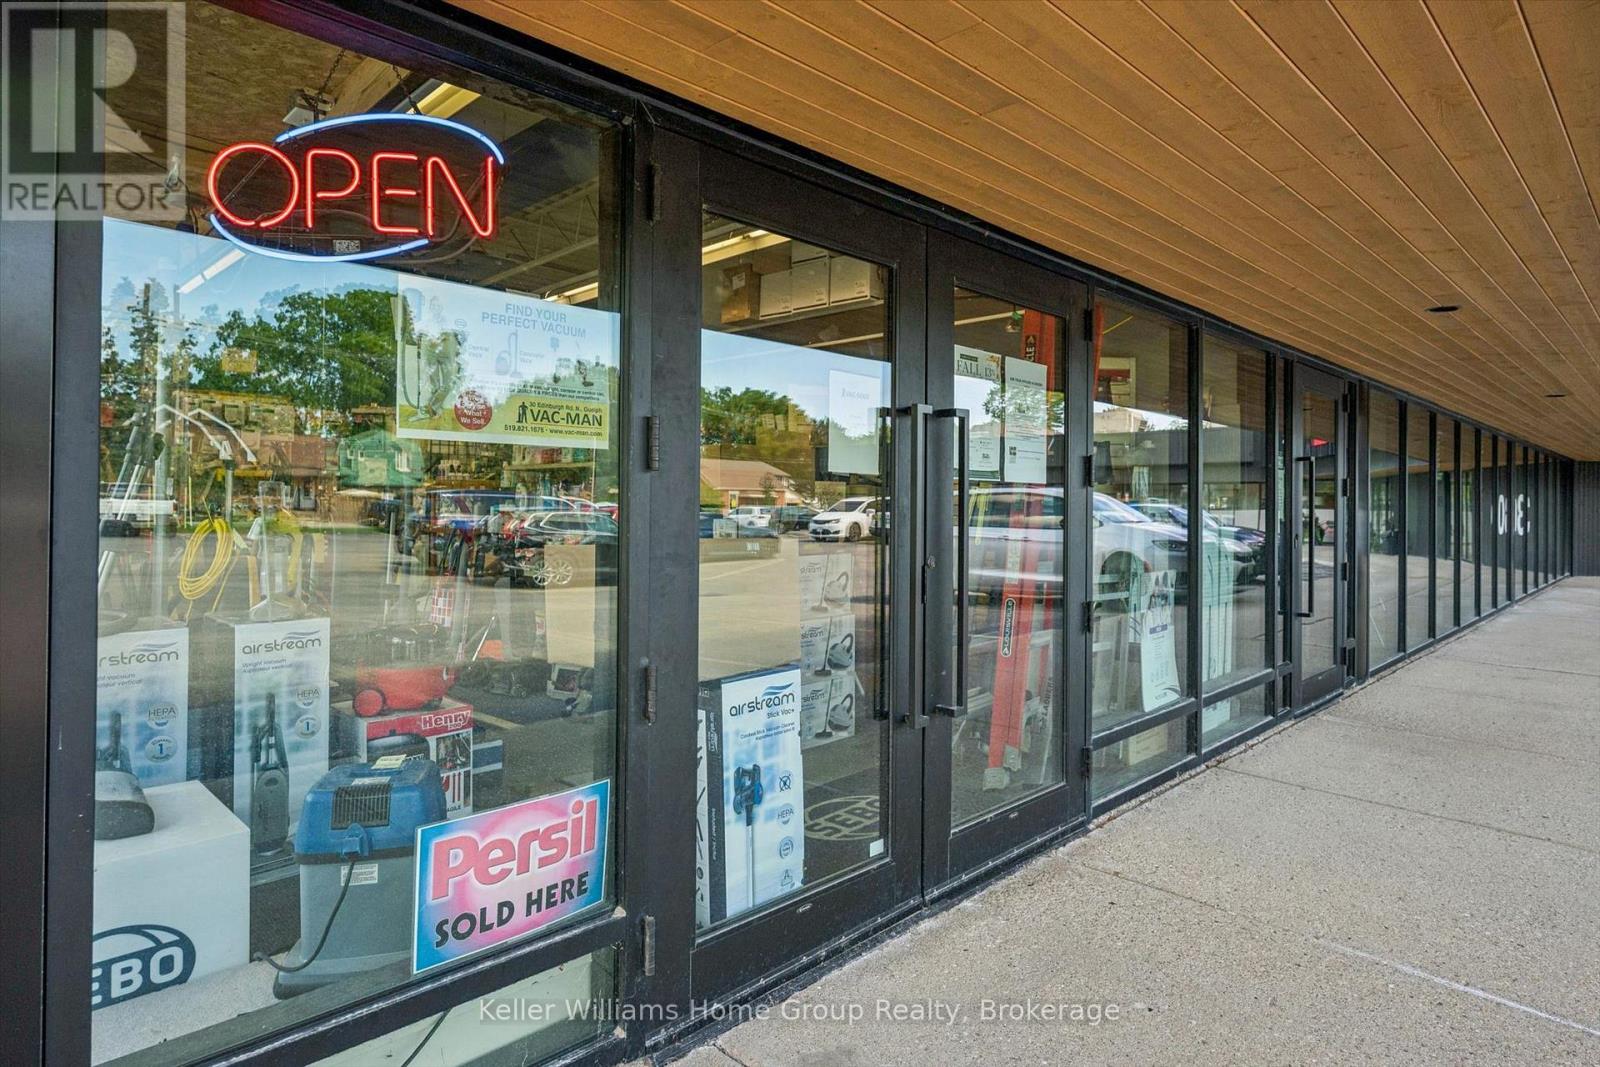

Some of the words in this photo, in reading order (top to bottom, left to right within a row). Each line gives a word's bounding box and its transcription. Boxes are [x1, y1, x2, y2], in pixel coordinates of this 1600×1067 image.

[207, 142, 495, 238] OPEN
[505, 303, 533, 317] FIND
[536, 309, 567, 323] YOUR
[481, 311, 538, 329] PERFECT
[540, 321, 586, 338] VACUUM
[957, 359, 982, 377] FALL
[530, 408, 602, 427] VAC-MAN
[242, 637, 322, 655] airstream
[297, 688, 320, 698] HEPA
[148, 706, 177, 719] HEPA
[729, 692, 795, 717] airstream
[421, 710, 471, 730] Henry
[777, 808, 794, 820] HEPA
[431, 799, 598, 901] Persil
[435, 899, 515, 948] SOLD
[525, 871, 589, 918] HERE
